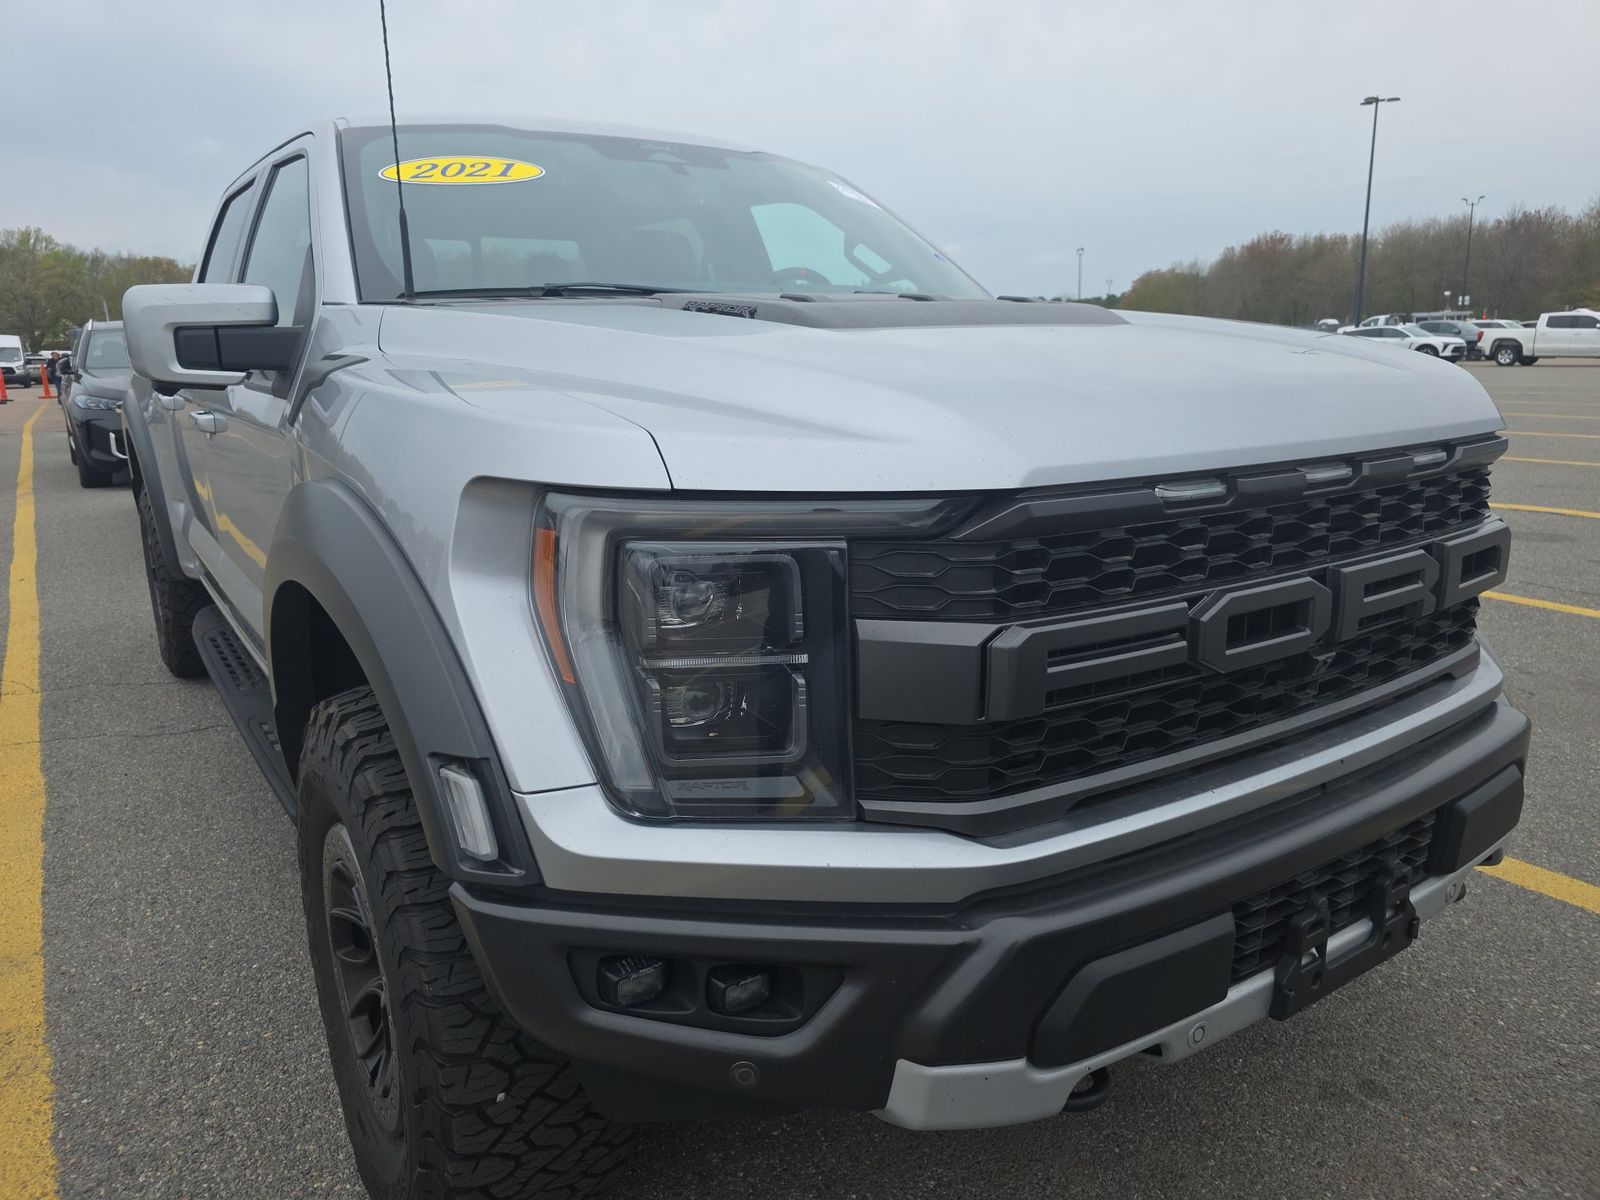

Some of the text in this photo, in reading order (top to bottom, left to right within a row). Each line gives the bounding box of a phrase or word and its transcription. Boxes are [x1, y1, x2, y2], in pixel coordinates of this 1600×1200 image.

[409, 161, 516, 180] 2021
[682, 300, 757, 319] RAPTOR
[988, 519, 1510, 722] FORD
